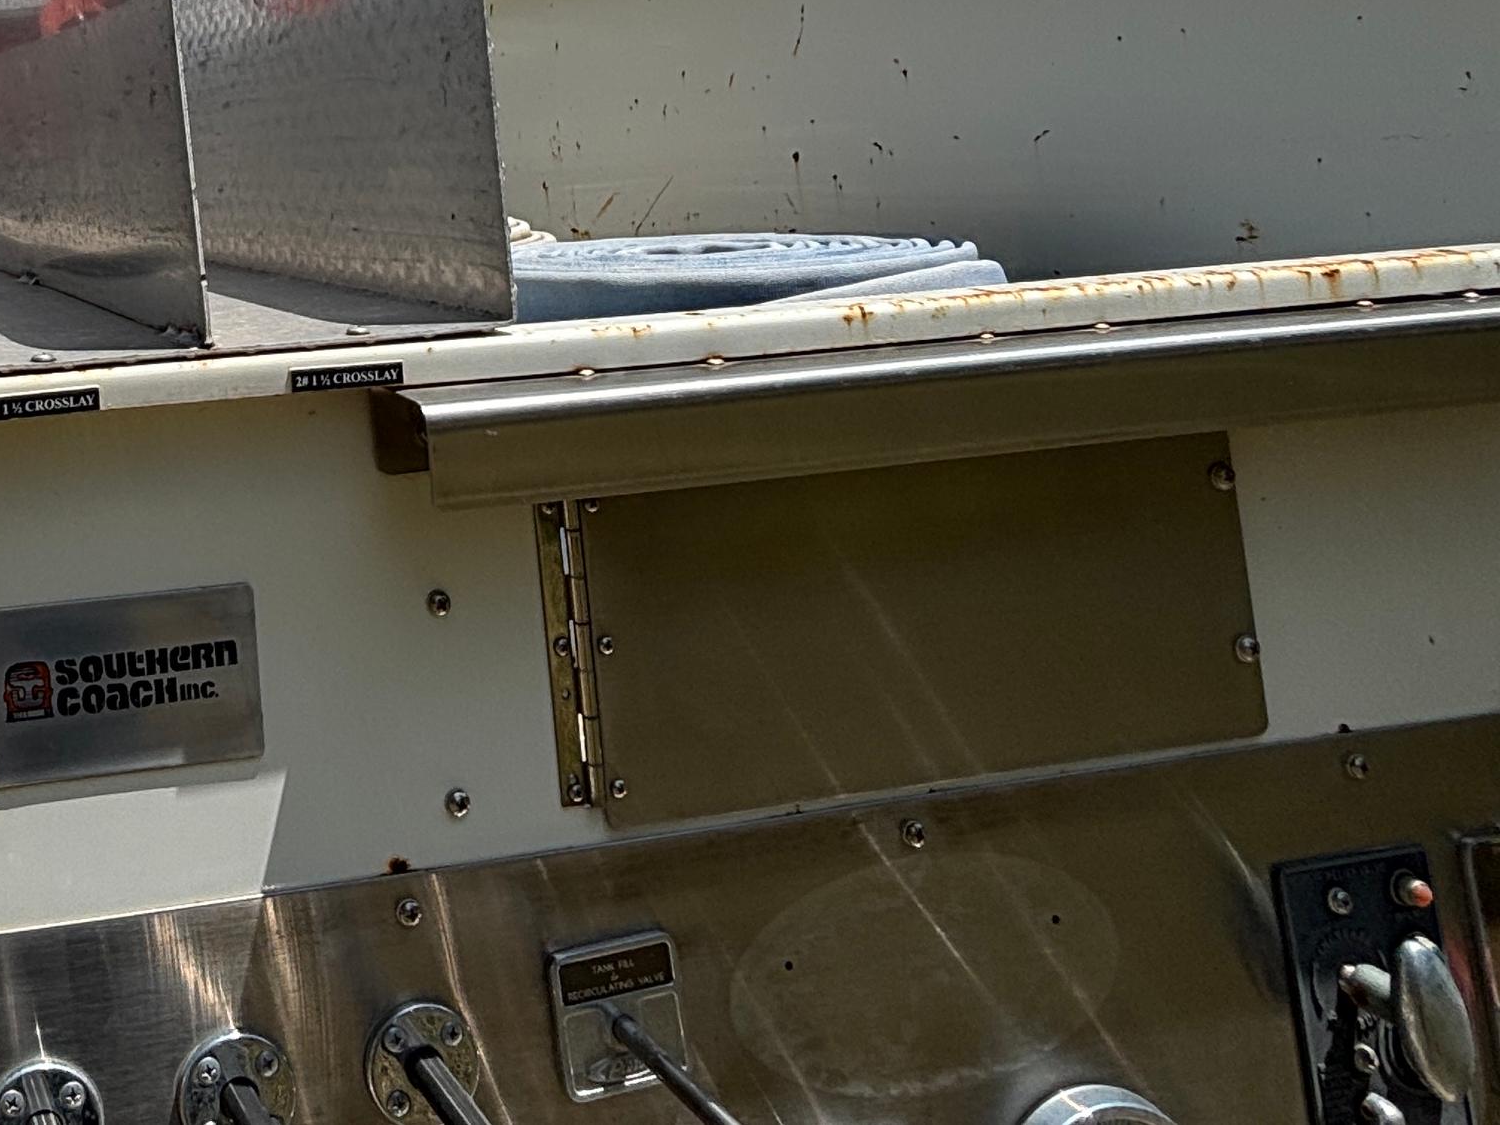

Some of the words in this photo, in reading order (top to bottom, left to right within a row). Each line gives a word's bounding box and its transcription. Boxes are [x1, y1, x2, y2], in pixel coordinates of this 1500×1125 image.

[332, 368, 400, 384] CROSSLAY
[25, 394, 96, 412] CROSSLAY
[592, 963, 615, 974] TANK
[618, 958, 635, 970] FILL
[637, 971, 665, 985] VALVE
